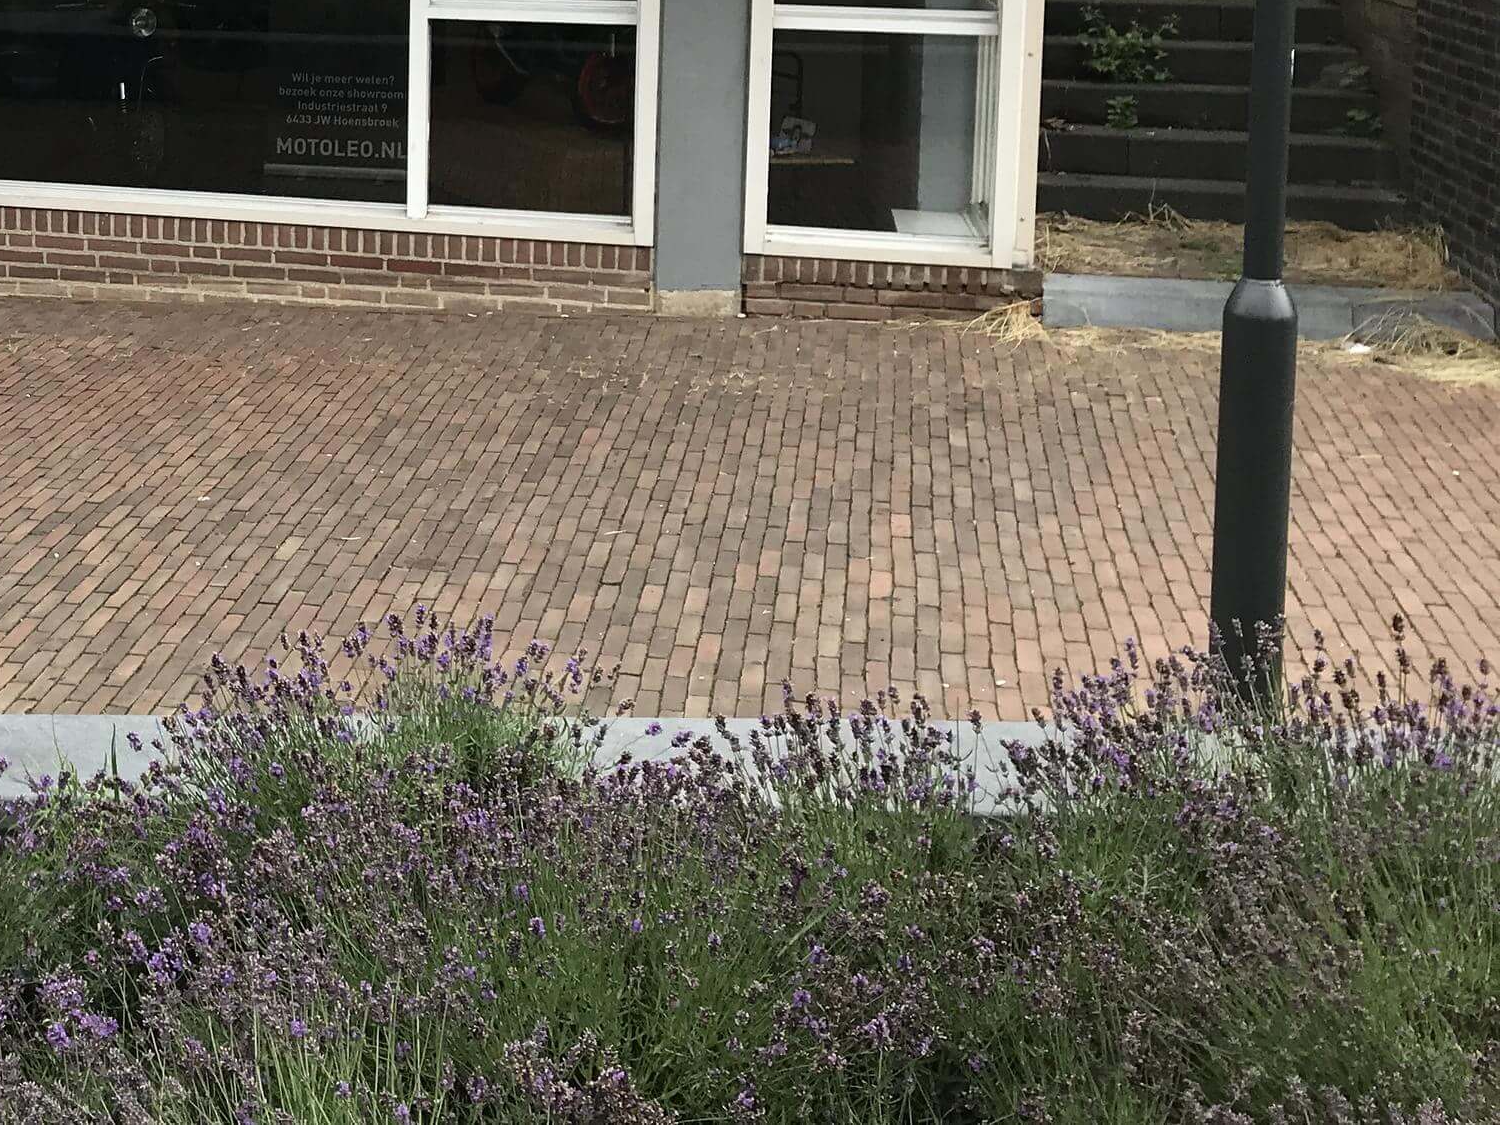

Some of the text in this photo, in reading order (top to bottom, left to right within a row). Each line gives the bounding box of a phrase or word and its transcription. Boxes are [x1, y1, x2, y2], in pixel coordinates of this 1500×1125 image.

[324, 74, 353, 84] meer
[319, 88, 344, 98] onze
[346, 88, 404, 99] showroom
[285, 114, 399, 128] 6433 JW Hoensbroek
[276, 136, 407, 159] MOTOLEO.NL
